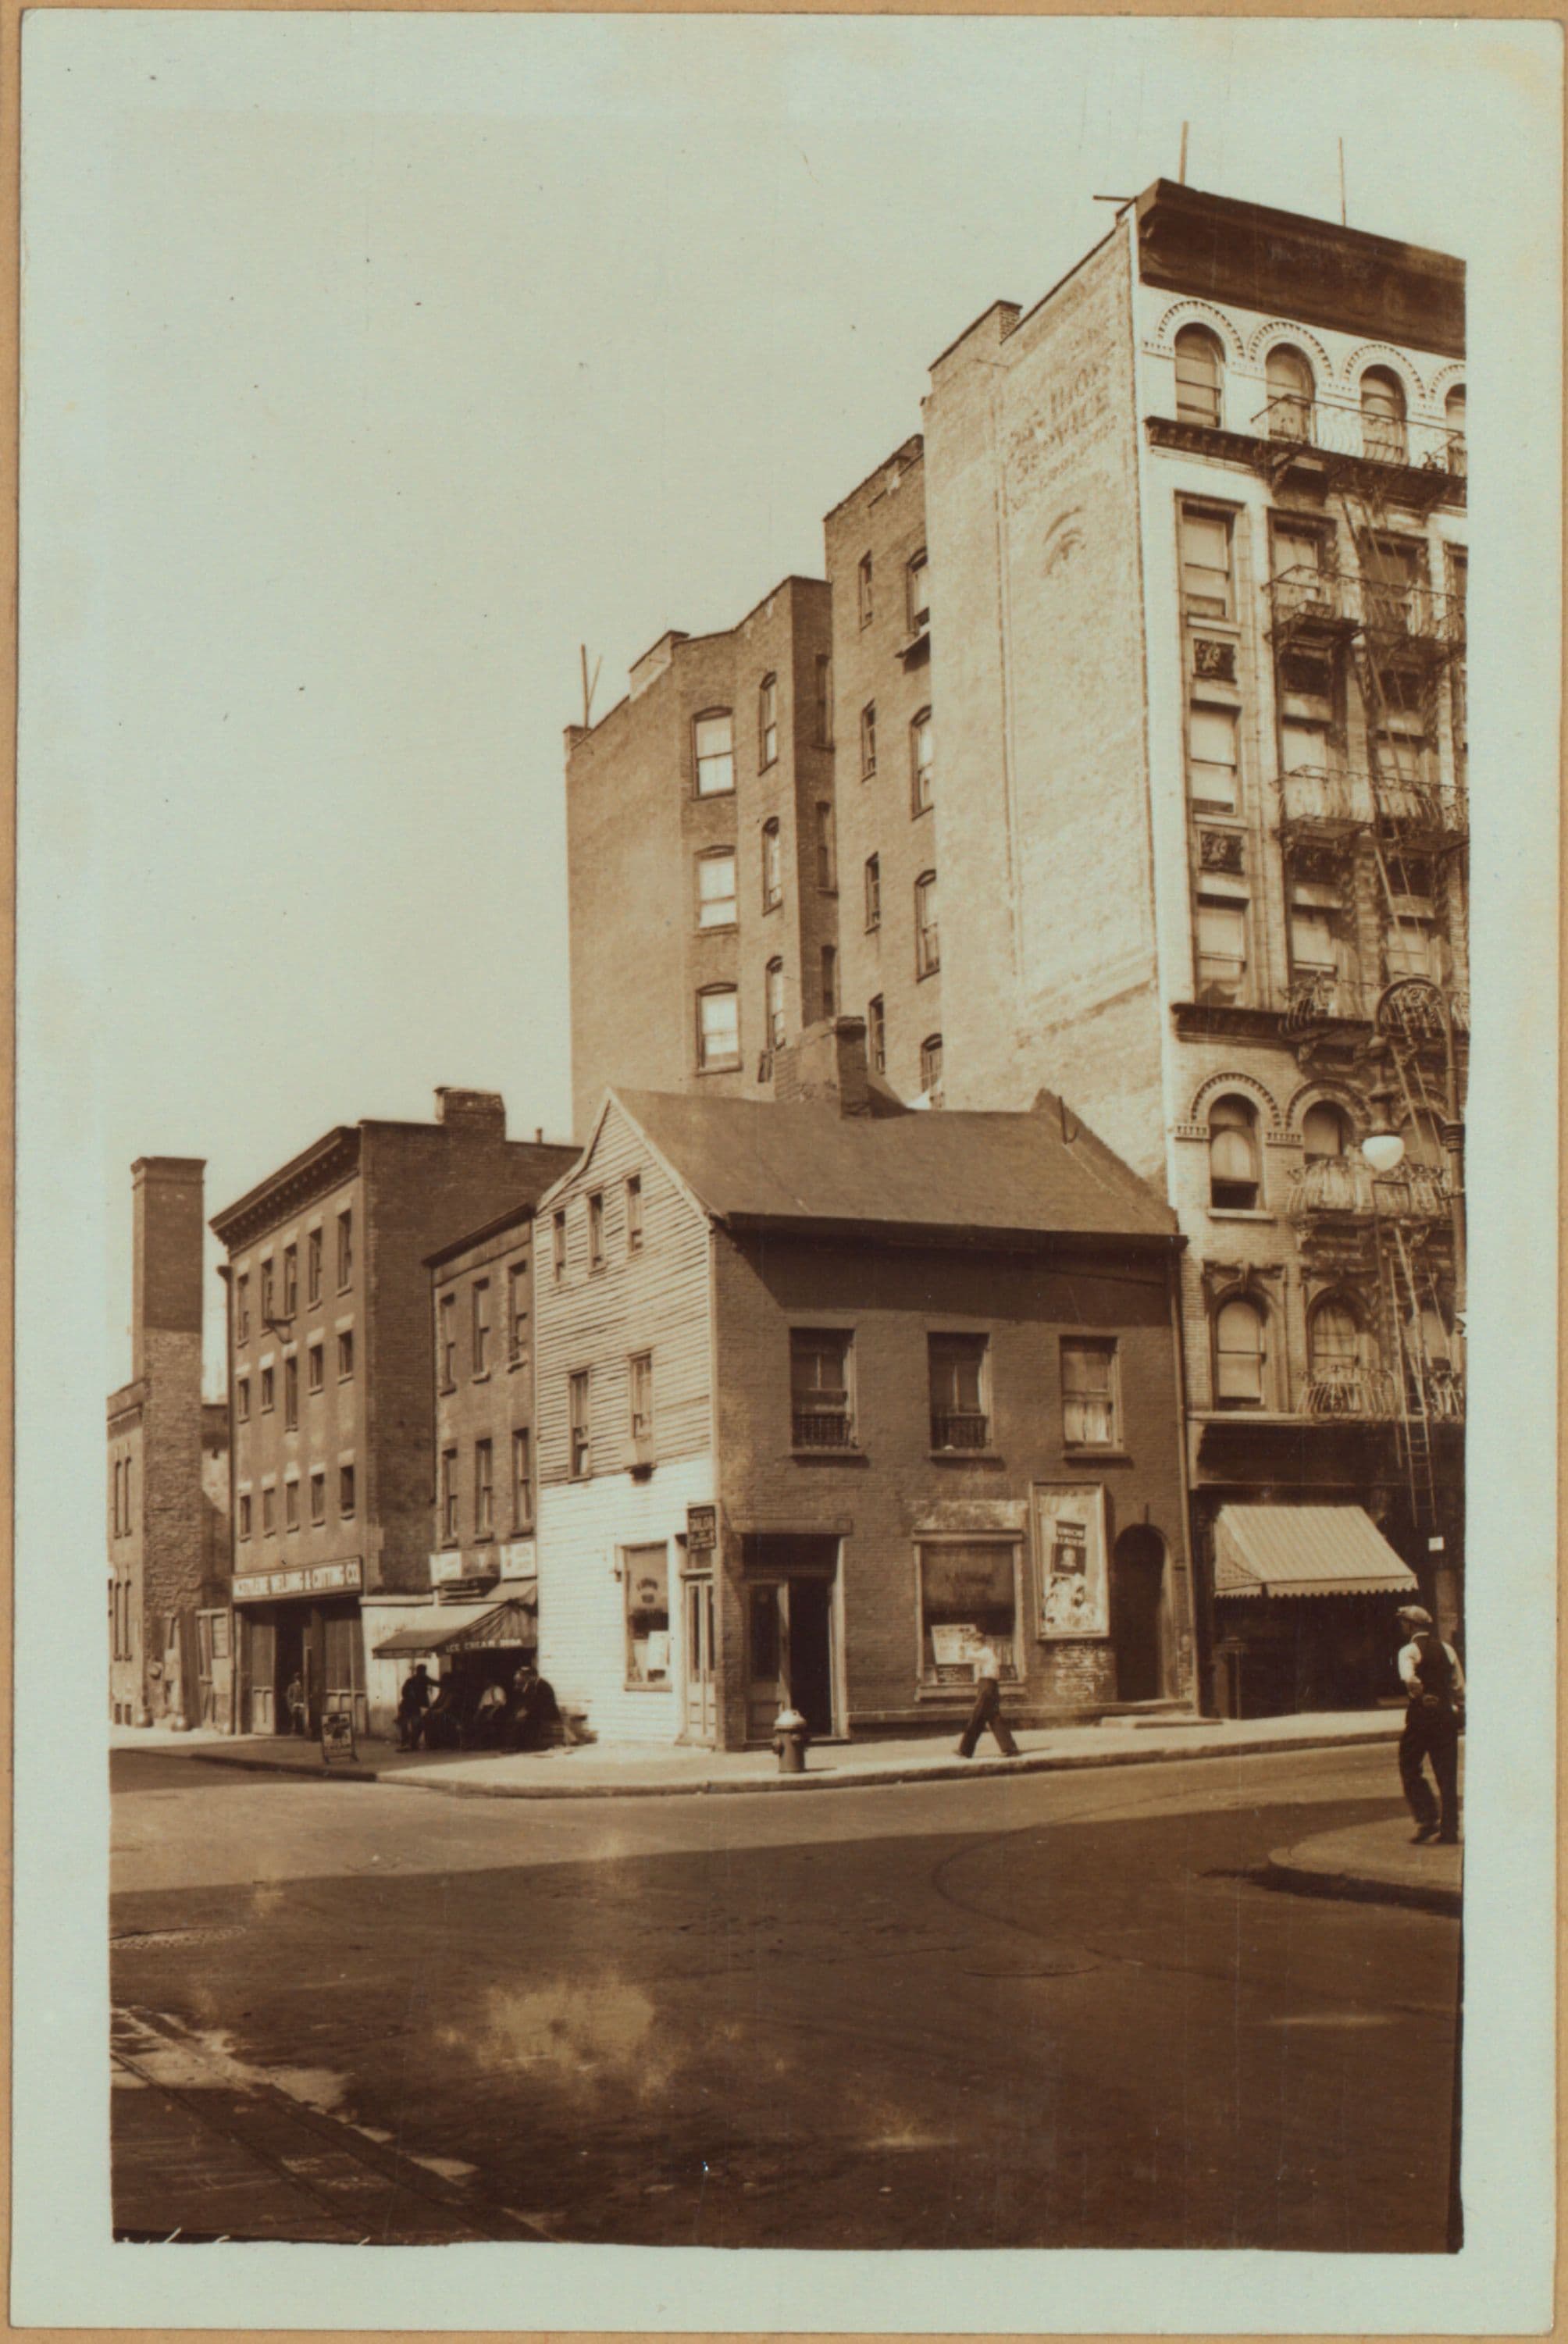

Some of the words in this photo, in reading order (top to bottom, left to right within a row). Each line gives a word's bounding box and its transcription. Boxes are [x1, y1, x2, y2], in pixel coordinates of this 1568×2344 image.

[271, 1570, 304, 1594] WELDING
[305, 1569, 312, 1591] &
[312, 1564, 345, 1589] CUTTING
[445, 1644, 461, 1653] ICE
[464, 1640, 496, 1650] CREAM
